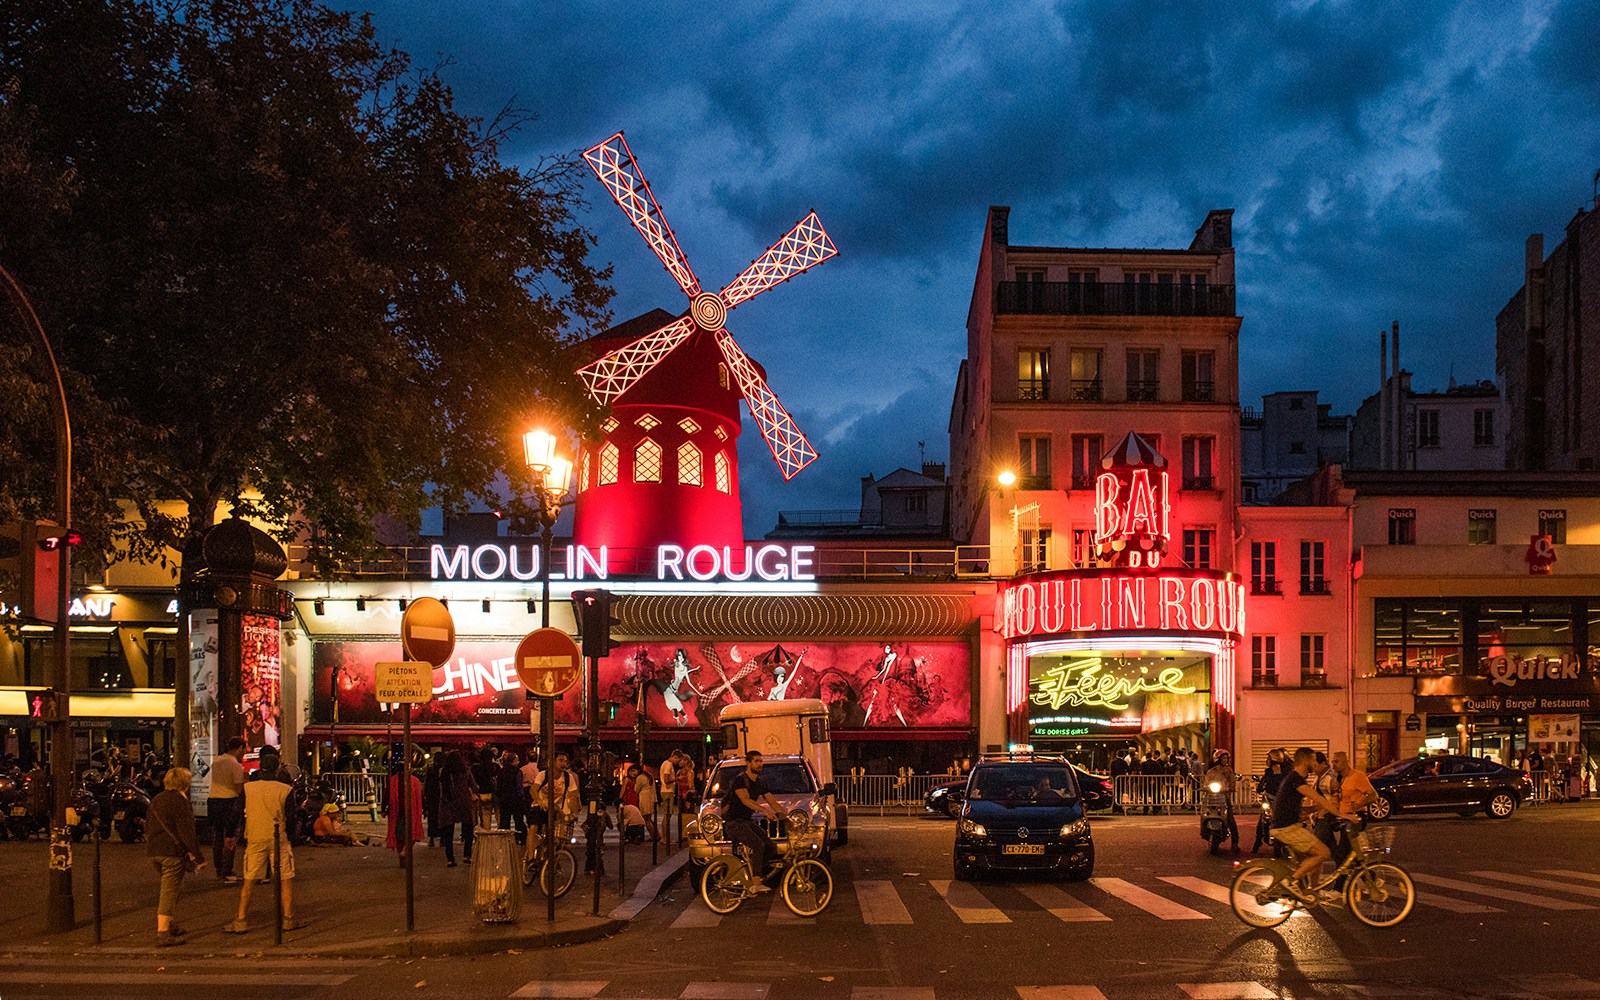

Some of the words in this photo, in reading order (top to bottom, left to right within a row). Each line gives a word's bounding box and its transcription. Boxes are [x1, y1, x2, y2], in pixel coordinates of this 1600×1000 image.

[1389, 510, 1415, 519] Quick
[1469, 510, 1495, 519] Quick
[1539, 511, 1565, 519] Quick
[1535, 538, 1553, 558] Q
[657, 544, 816, 581] ROUGE
[1129, 552, 1160, 569] DU
[388, 667, 418, 675] PIÉTONS
[1490, 653, 1579, 687] Quick
[386, 678, 421, 686] ATTENTION
[1467, 700, 1500, 710] Quality
[1505, 700, 1537, 710] Burger
[1540, 699, 1590, 708] Restaurant
[477, 707, 506, 715] CONCERTS
